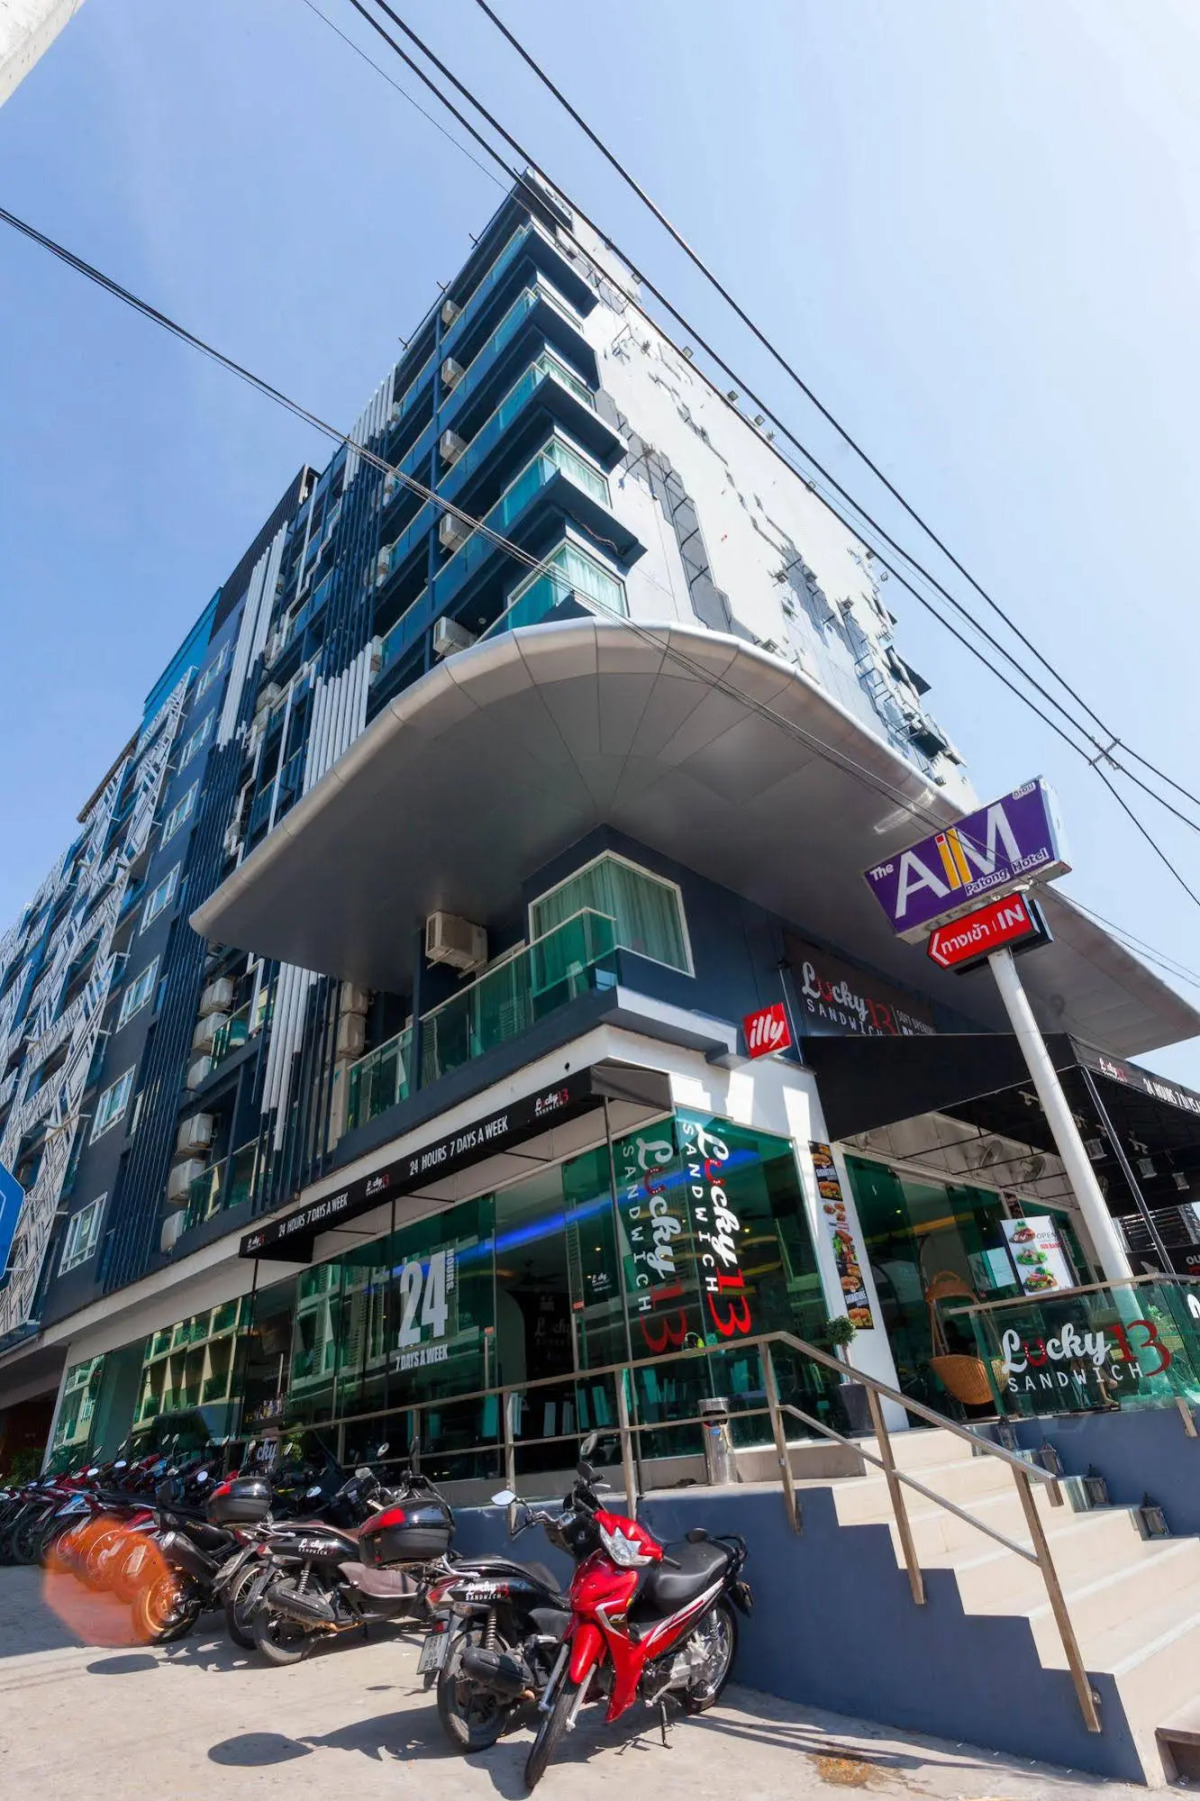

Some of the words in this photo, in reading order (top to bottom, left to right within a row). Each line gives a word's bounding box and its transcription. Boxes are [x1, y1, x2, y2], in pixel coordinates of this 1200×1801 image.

[870, 863, 894, 881] The
[965, 869, 1010, 896] Patong
[1011, 847, 1049, 874] Hotel
[996, 904, 1025, 930] IN
[941, 923, 989, 954] ทางเข้า
[750, 1014, 784, 1048] illy
[409, 1161, 419, 1176] 24
[421, 1145, 448, 1171] HOURS
[450, 1141, 455, 1156] 7
[456, 1134, 476, 1153] DAYS
[477, 1128, 485, 1142] A
[485, 1115, 508, 1140] WEEK
[287, 1213, 305, 1233] HOURS
[311, 1204, 326, 1221] DAYS
[331, 1192, 349, 1211] WEEK
[682, 1122, 718, 1292] SANDWICH
[622, 1145, 652, 1311] SANDWICH
[446, 1248, 455, 1293] HOURS
[398, 1250, 448, 1347] 24
[401, 1351, 420, 1370] DAYS
[420, 1350, 426, 1366] A
[426, 1344, 448, 1364] WEEK
[1008, 1362, 1143, 1392] SANDWICH
